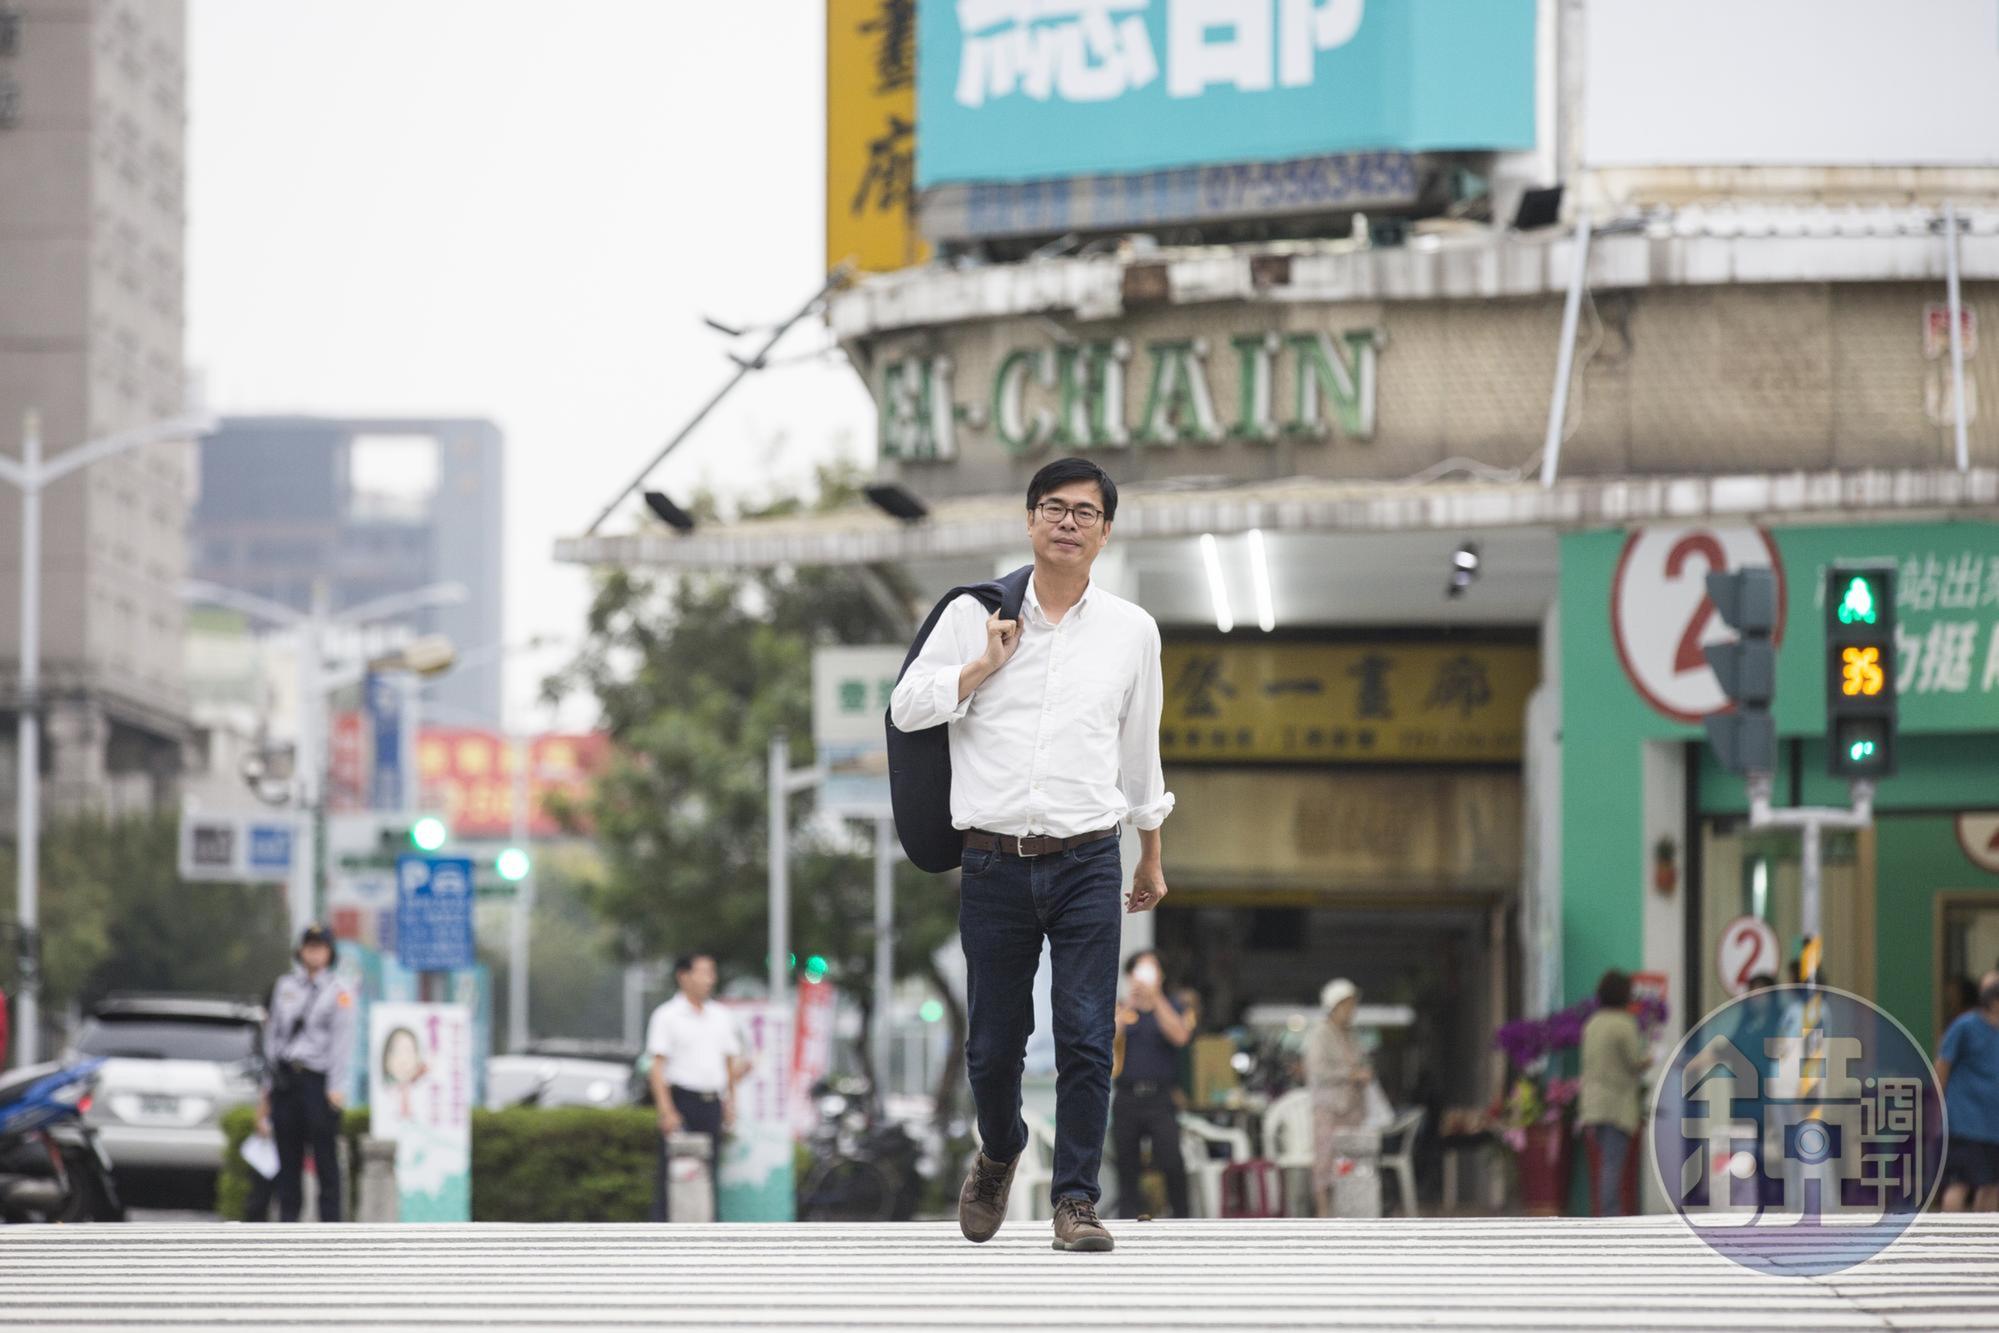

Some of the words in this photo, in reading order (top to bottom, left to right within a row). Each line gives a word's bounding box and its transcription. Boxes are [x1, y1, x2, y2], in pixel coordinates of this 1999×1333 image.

[1664, 529, 1741, 678] 2
[1842, 646, 1884, 696] 35
[1894, 620, 1999, 694] 力挺
[1733, 928, 1764, 988] 2
